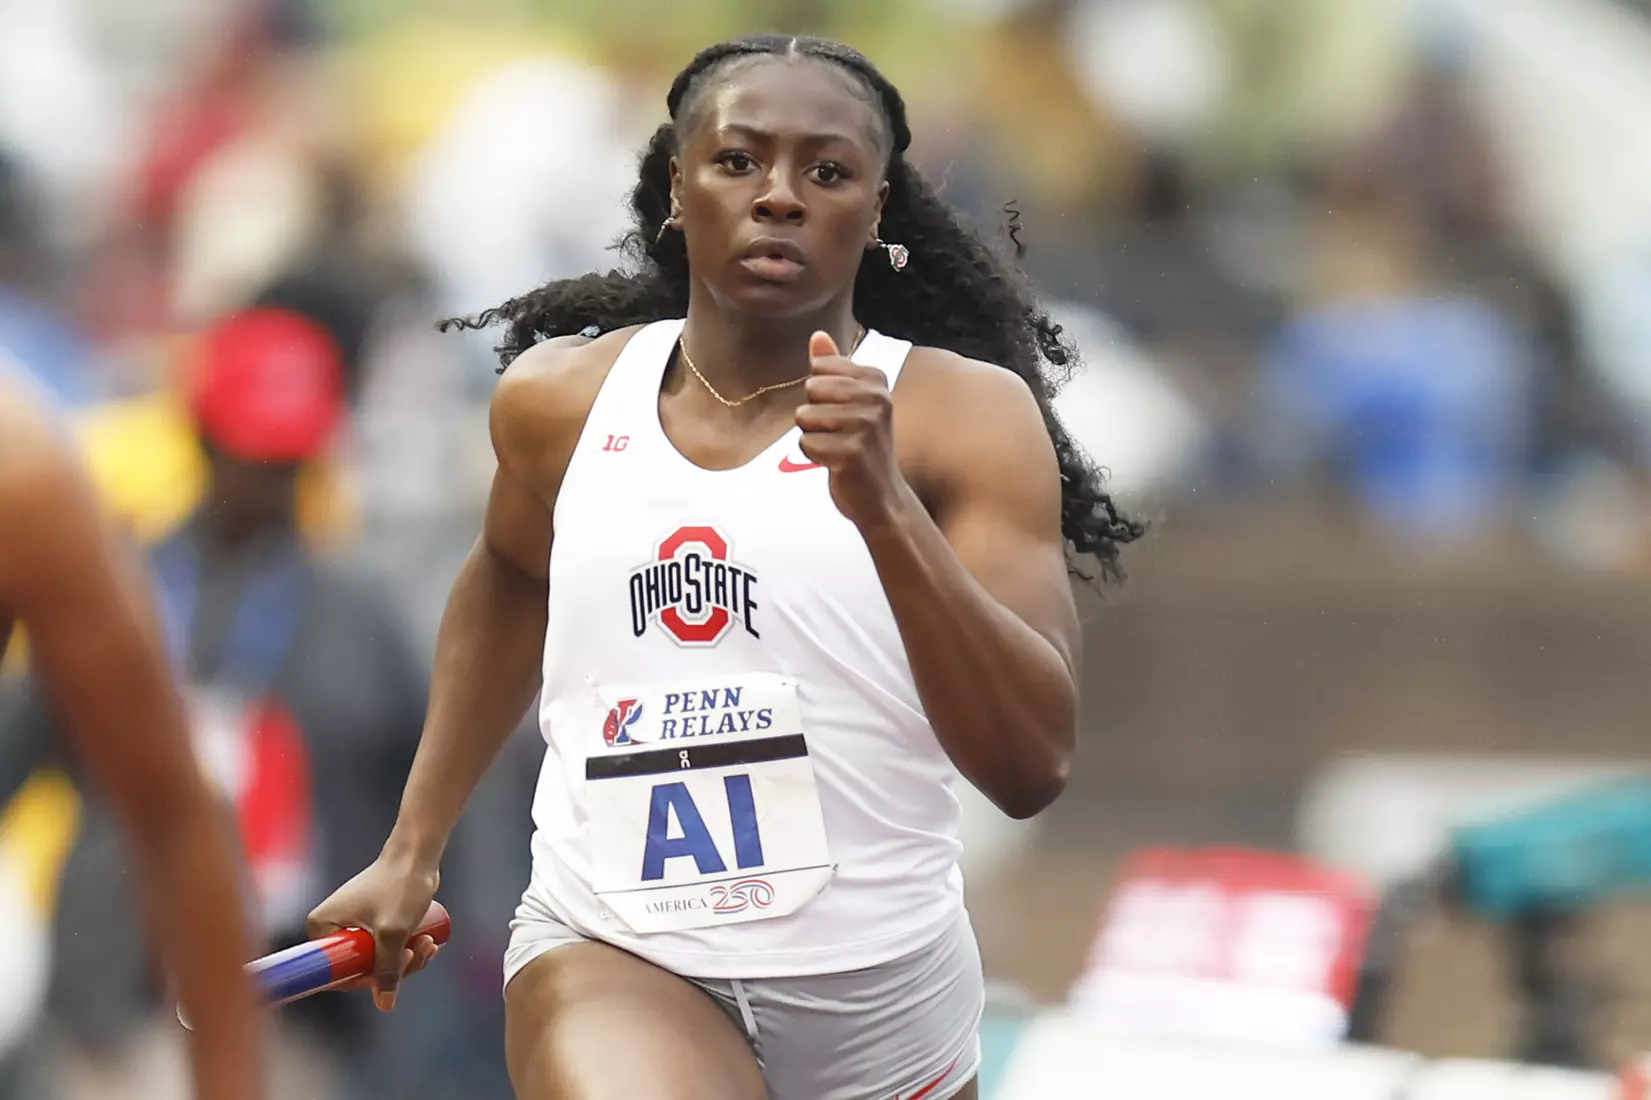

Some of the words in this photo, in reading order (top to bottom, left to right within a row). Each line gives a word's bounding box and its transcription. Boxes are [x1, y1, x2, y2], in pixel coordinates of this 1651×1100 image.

[629, 561, 683, 638] OHIO
[684, 553, 761, 640] STATE
[662, 686, 744, 715] PENN
[659, 708, 773, 741] RELAYS
[645, 898, 708, 914] AMERICA
[709, 879, 775, 915] 250
